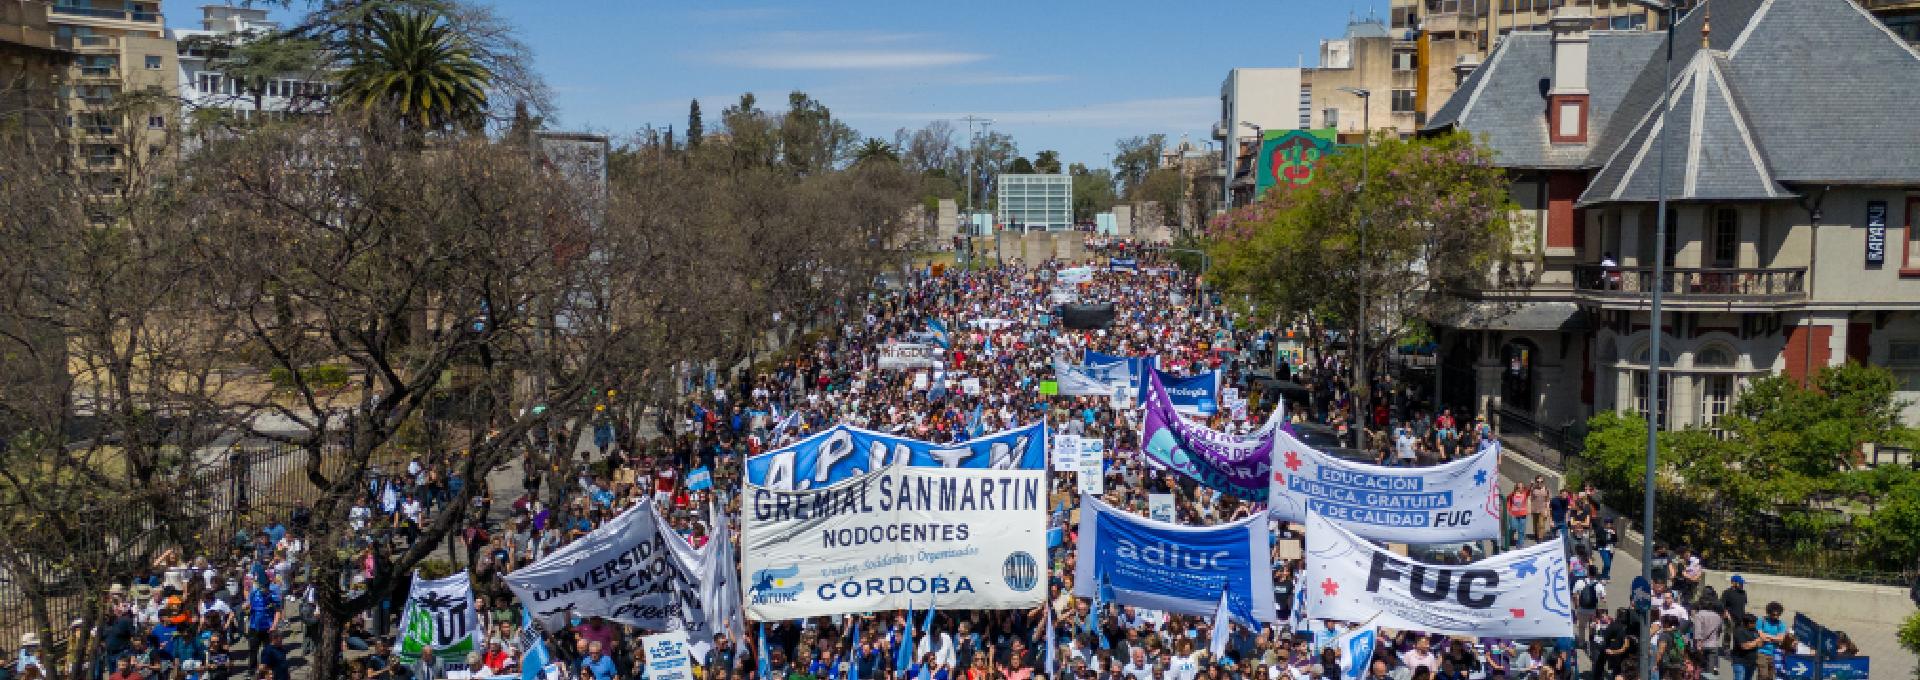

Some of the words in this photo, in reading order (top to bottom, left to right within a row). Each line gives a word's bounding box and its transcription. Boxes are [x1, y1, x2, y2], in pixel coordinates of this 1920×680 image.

[755, 479, 873, 520] GREMIAL
[1366, 494, 1448, 508] GRATUITA
[1315, 503, 1323, 513] Y
[1329, 505, 1347, 518] DE
[1352, 510, 1424, 526] CALIDAD
[1434, 510, 1472, 527] FUC
[1116, 538, 1229, 570] adiuc
[817, 575, 976, 600] CÓRDOBA
[1366, 551, 1499, 609] FUC
